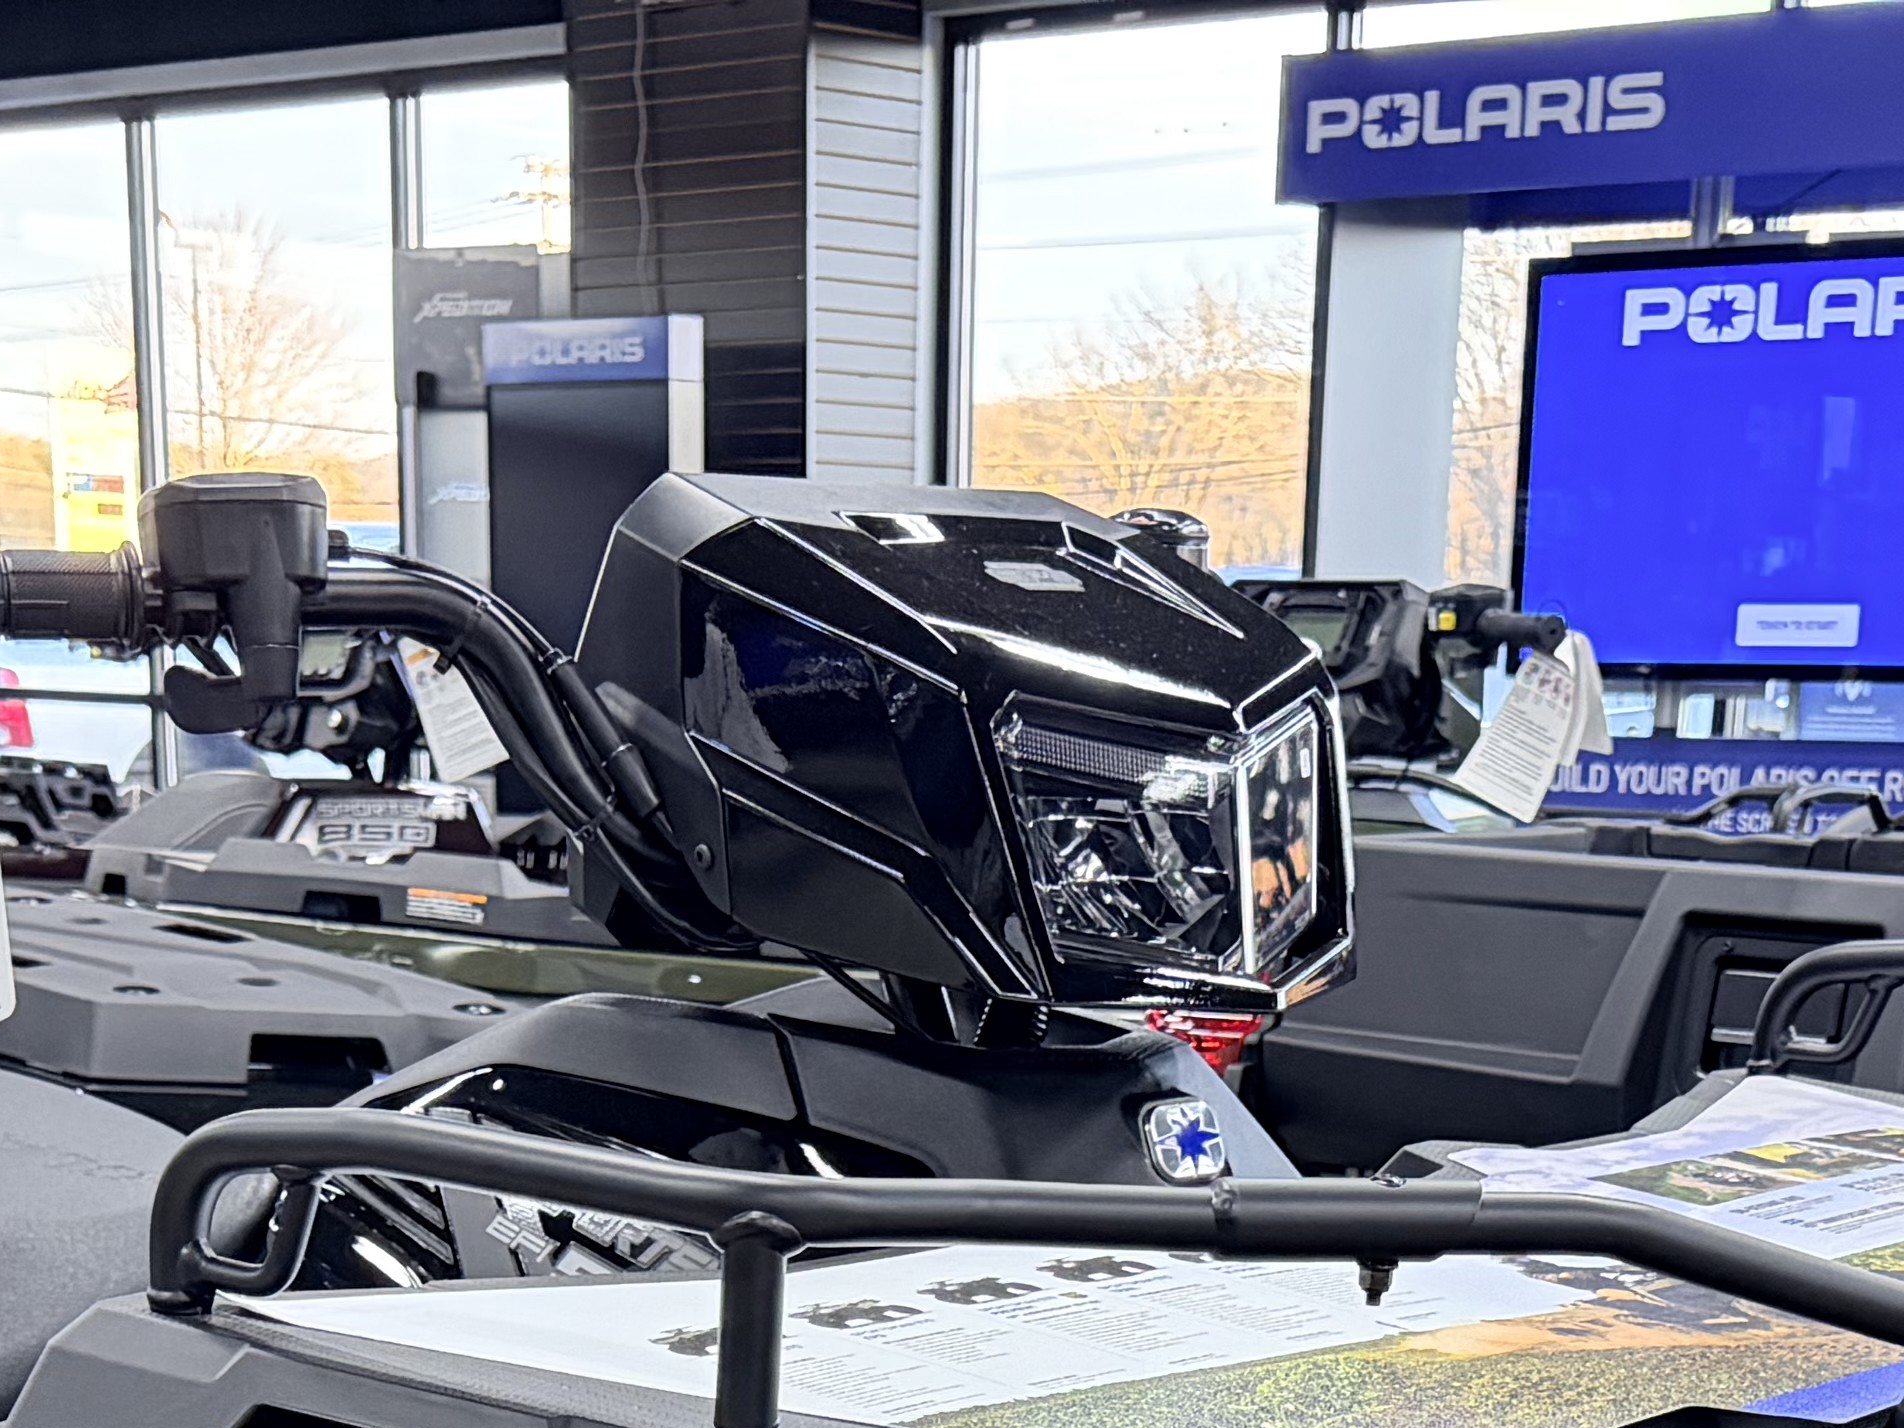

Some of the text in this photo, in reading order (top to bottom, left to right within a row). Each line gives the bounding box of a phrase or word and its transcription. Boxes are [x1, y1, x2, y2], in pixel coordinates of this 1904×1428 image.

[1306, 71, 1666, 154] POLARIS
[1550, 764, 1610, 794] UILD
[1614, 764, 1689, 796] YOUR
[317, 822, 436, 848] 850
[485, 1213, 562, 1264] EFI
